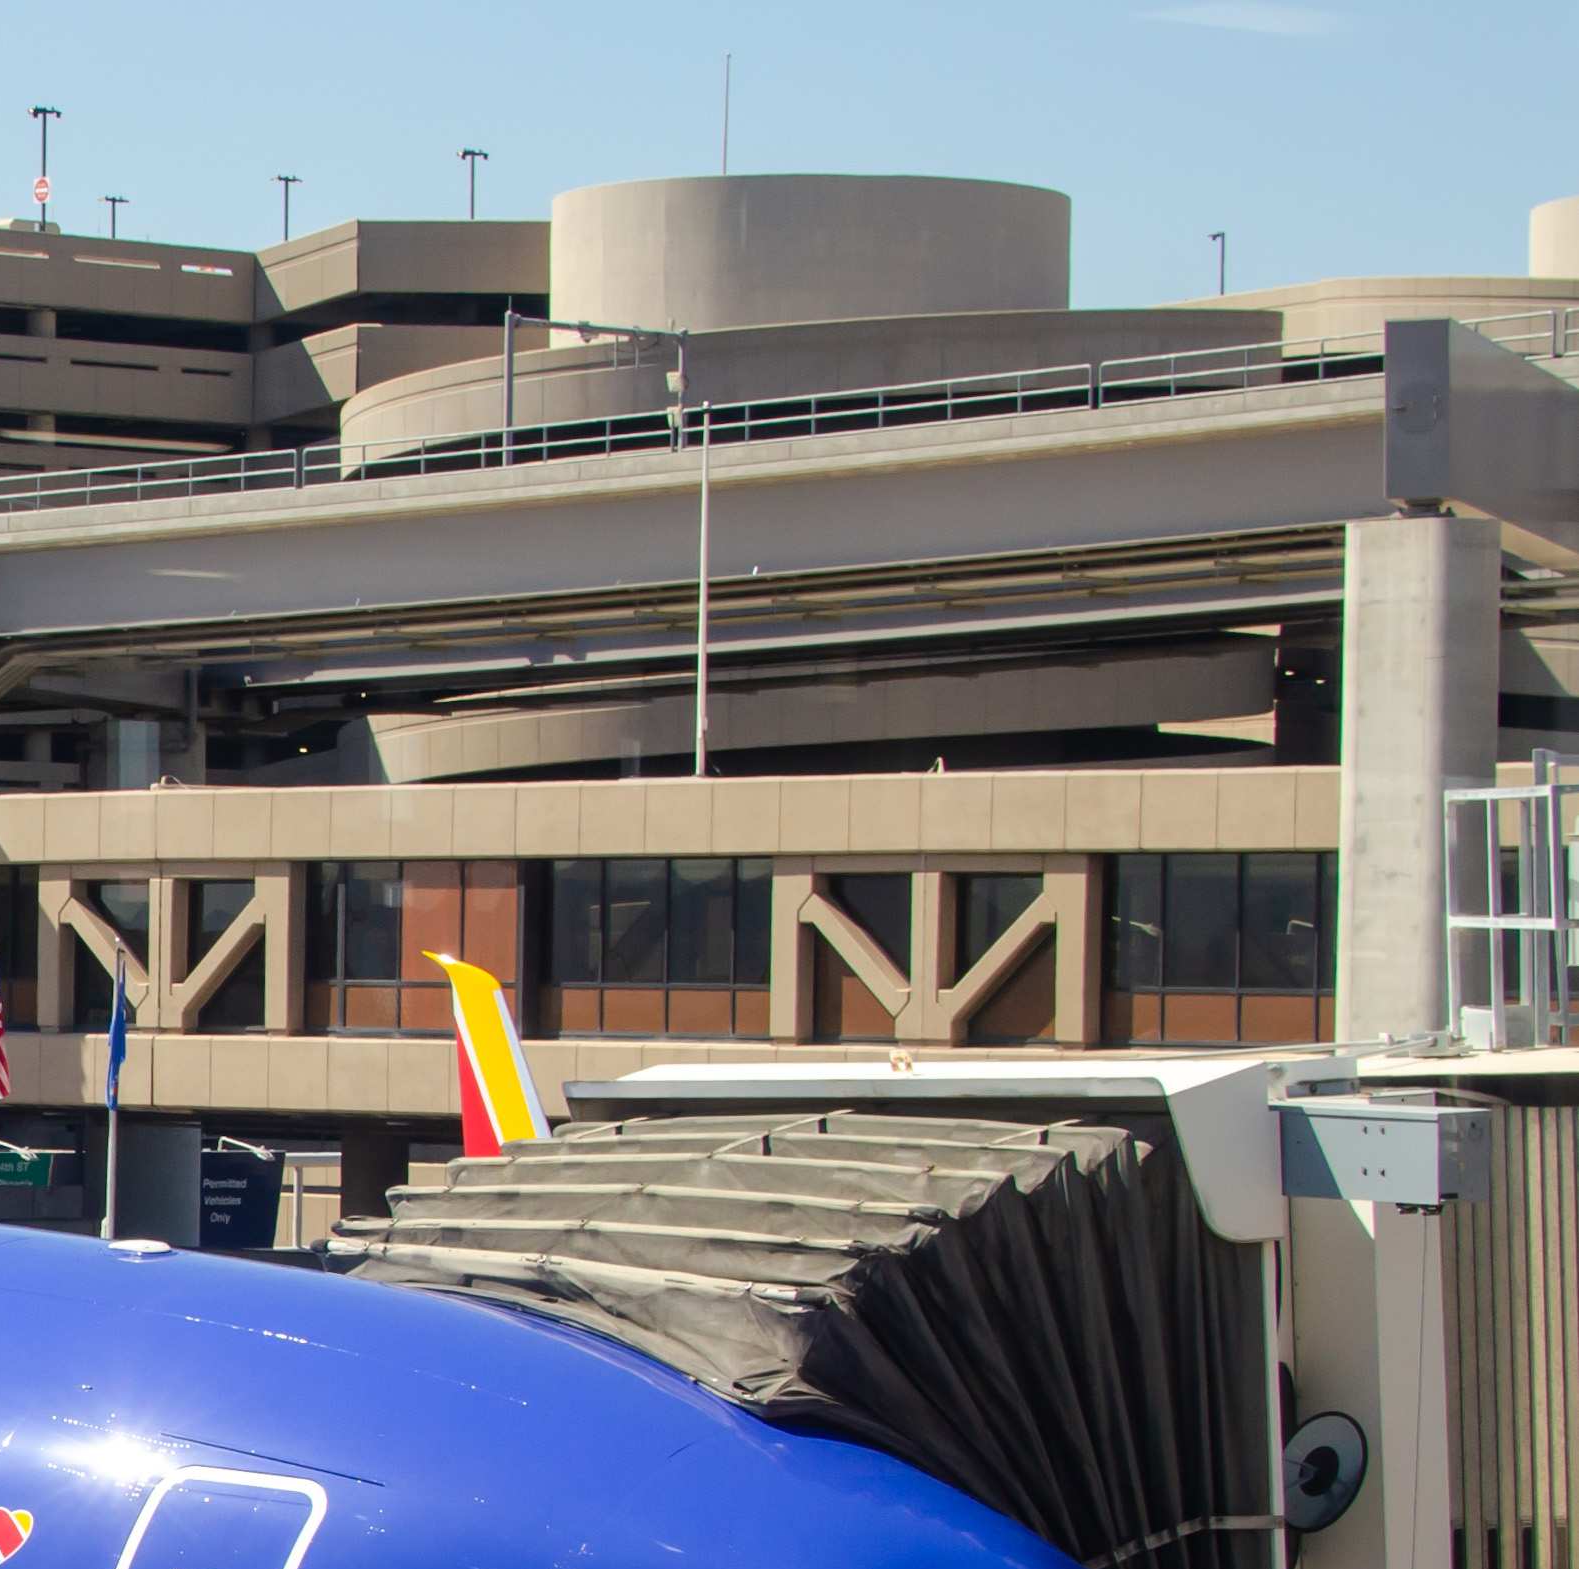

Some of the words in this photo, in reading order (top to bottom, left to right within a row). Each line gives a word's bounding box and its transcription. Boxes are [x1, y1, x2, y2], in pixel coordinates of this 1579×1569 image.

[16, 1161, 31, 1172] ST
[202, 1178, 248, 1189] Permitted
[204, 1196, 242, 1206] Vehicles
[210, 1211, 231, 1225] Only
